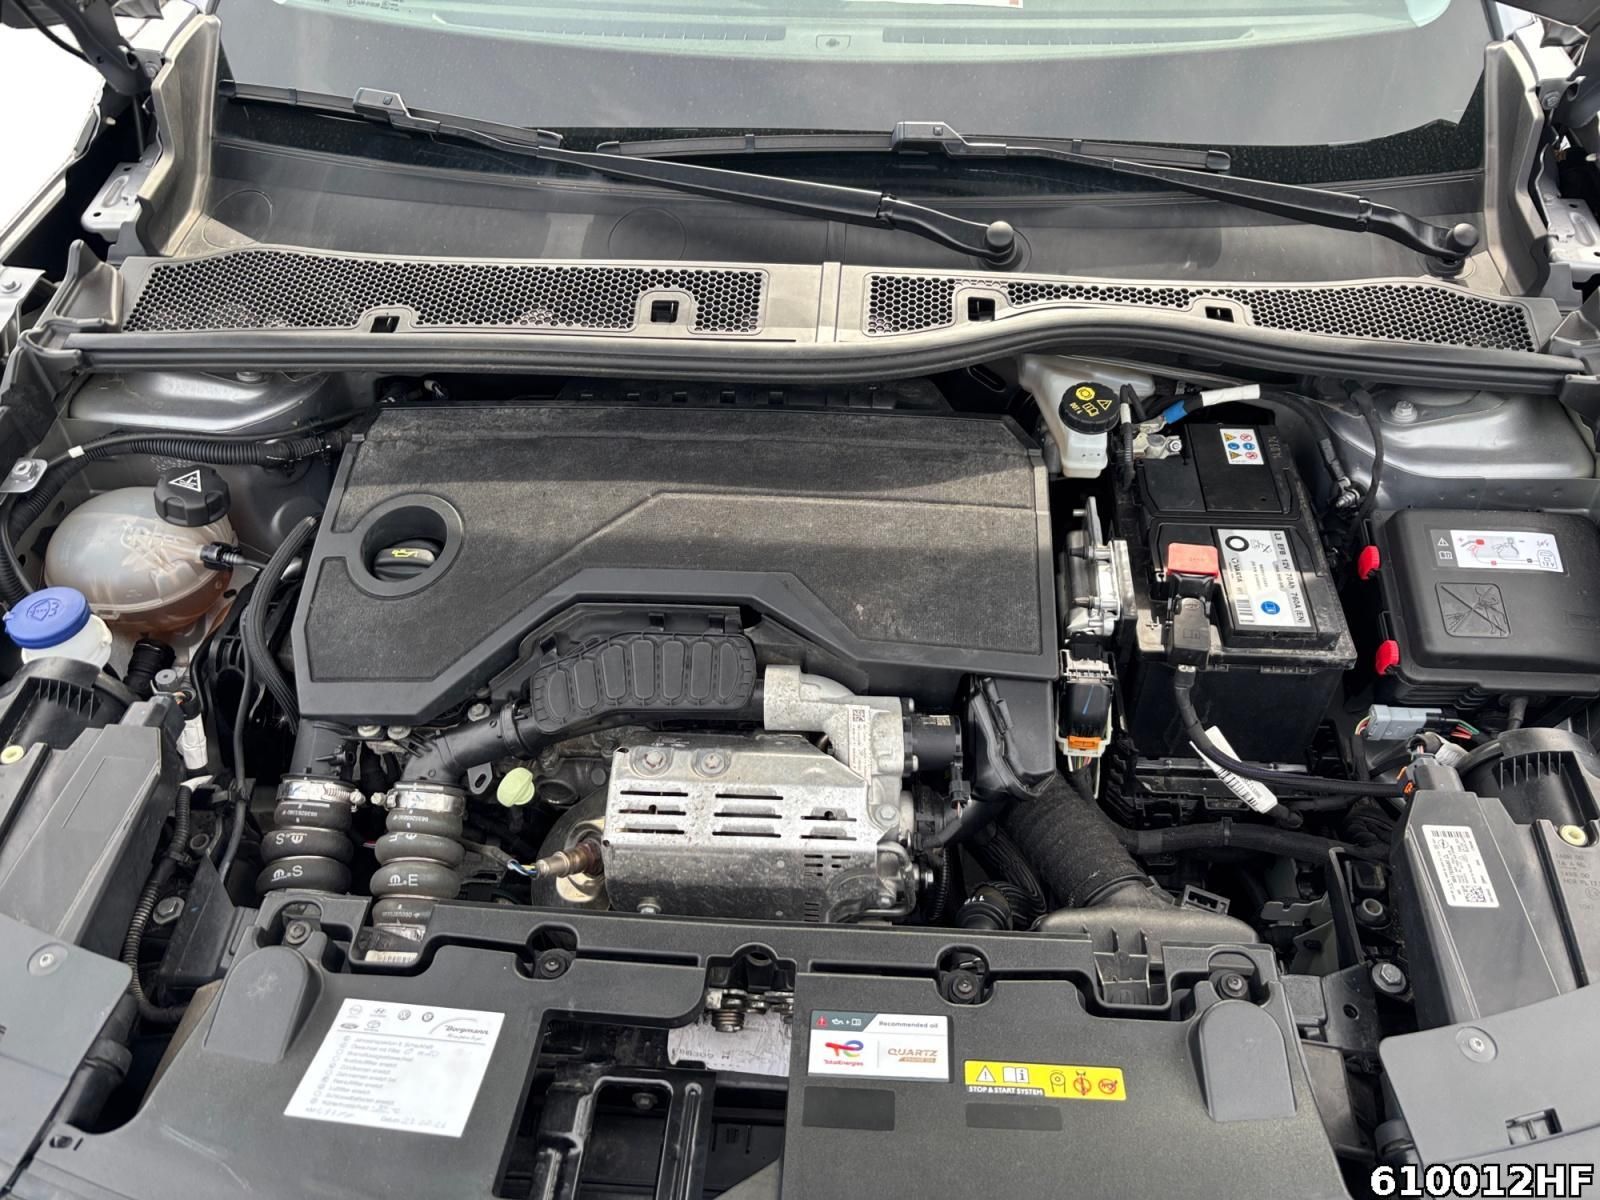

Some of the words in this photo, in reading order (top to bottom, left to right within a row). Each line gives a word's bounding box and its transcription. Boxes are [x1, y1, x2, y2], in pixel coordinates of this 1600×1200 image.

[1277, 543, 1287, 555] EFB
[1281, 559, 1292, 571] 12V
[292, 865, 304, 877] S
[408, 873, 419, 886] E
[878, 1020, 929, 1029] Recommended
[887, 1047, 939, 1057] QUARTZ
[823, 1058, 864, 1067] TotalEnergies
[968, 1085, 987, 1093] STOP
[987, 1086, 994, 1094] &
[993, 1087, 1016, 1095] START
[1016, 1088, 1044, 1097] SYSTEM
